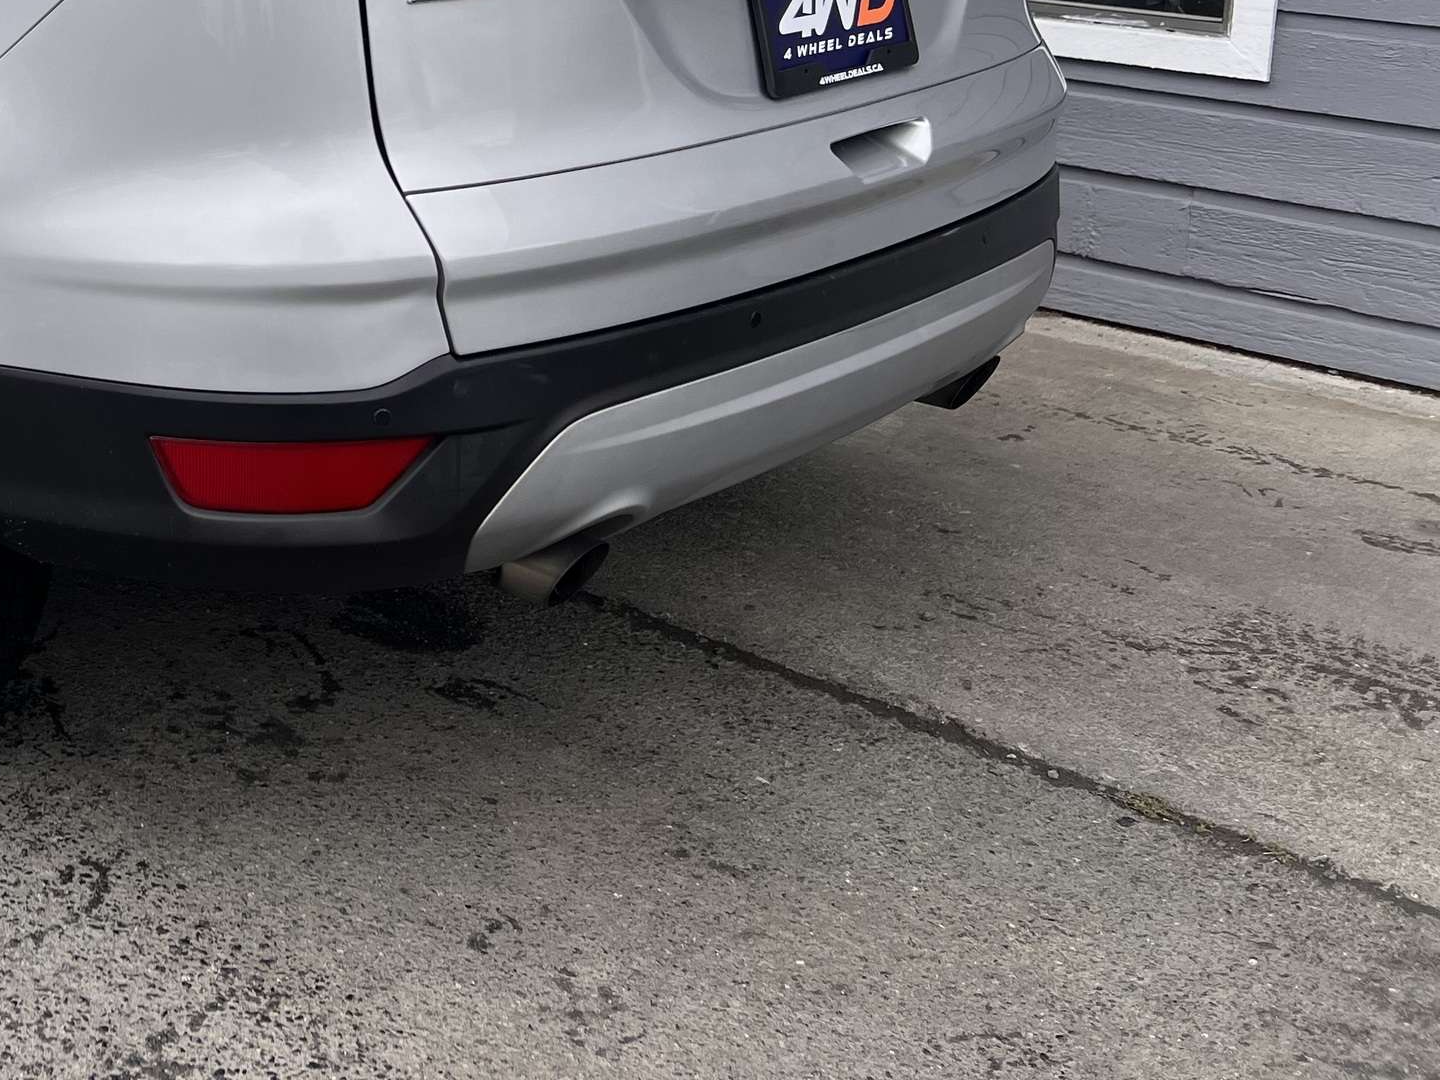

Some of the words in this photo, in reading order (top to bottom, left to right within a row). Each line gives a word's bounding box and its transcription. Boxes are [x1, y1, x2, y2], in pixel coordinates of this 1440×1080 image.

[783, 47, 793, 60] 4
[796, 37, 843, 58] WHEEL
[847, 26, 893, 48] DEALS
